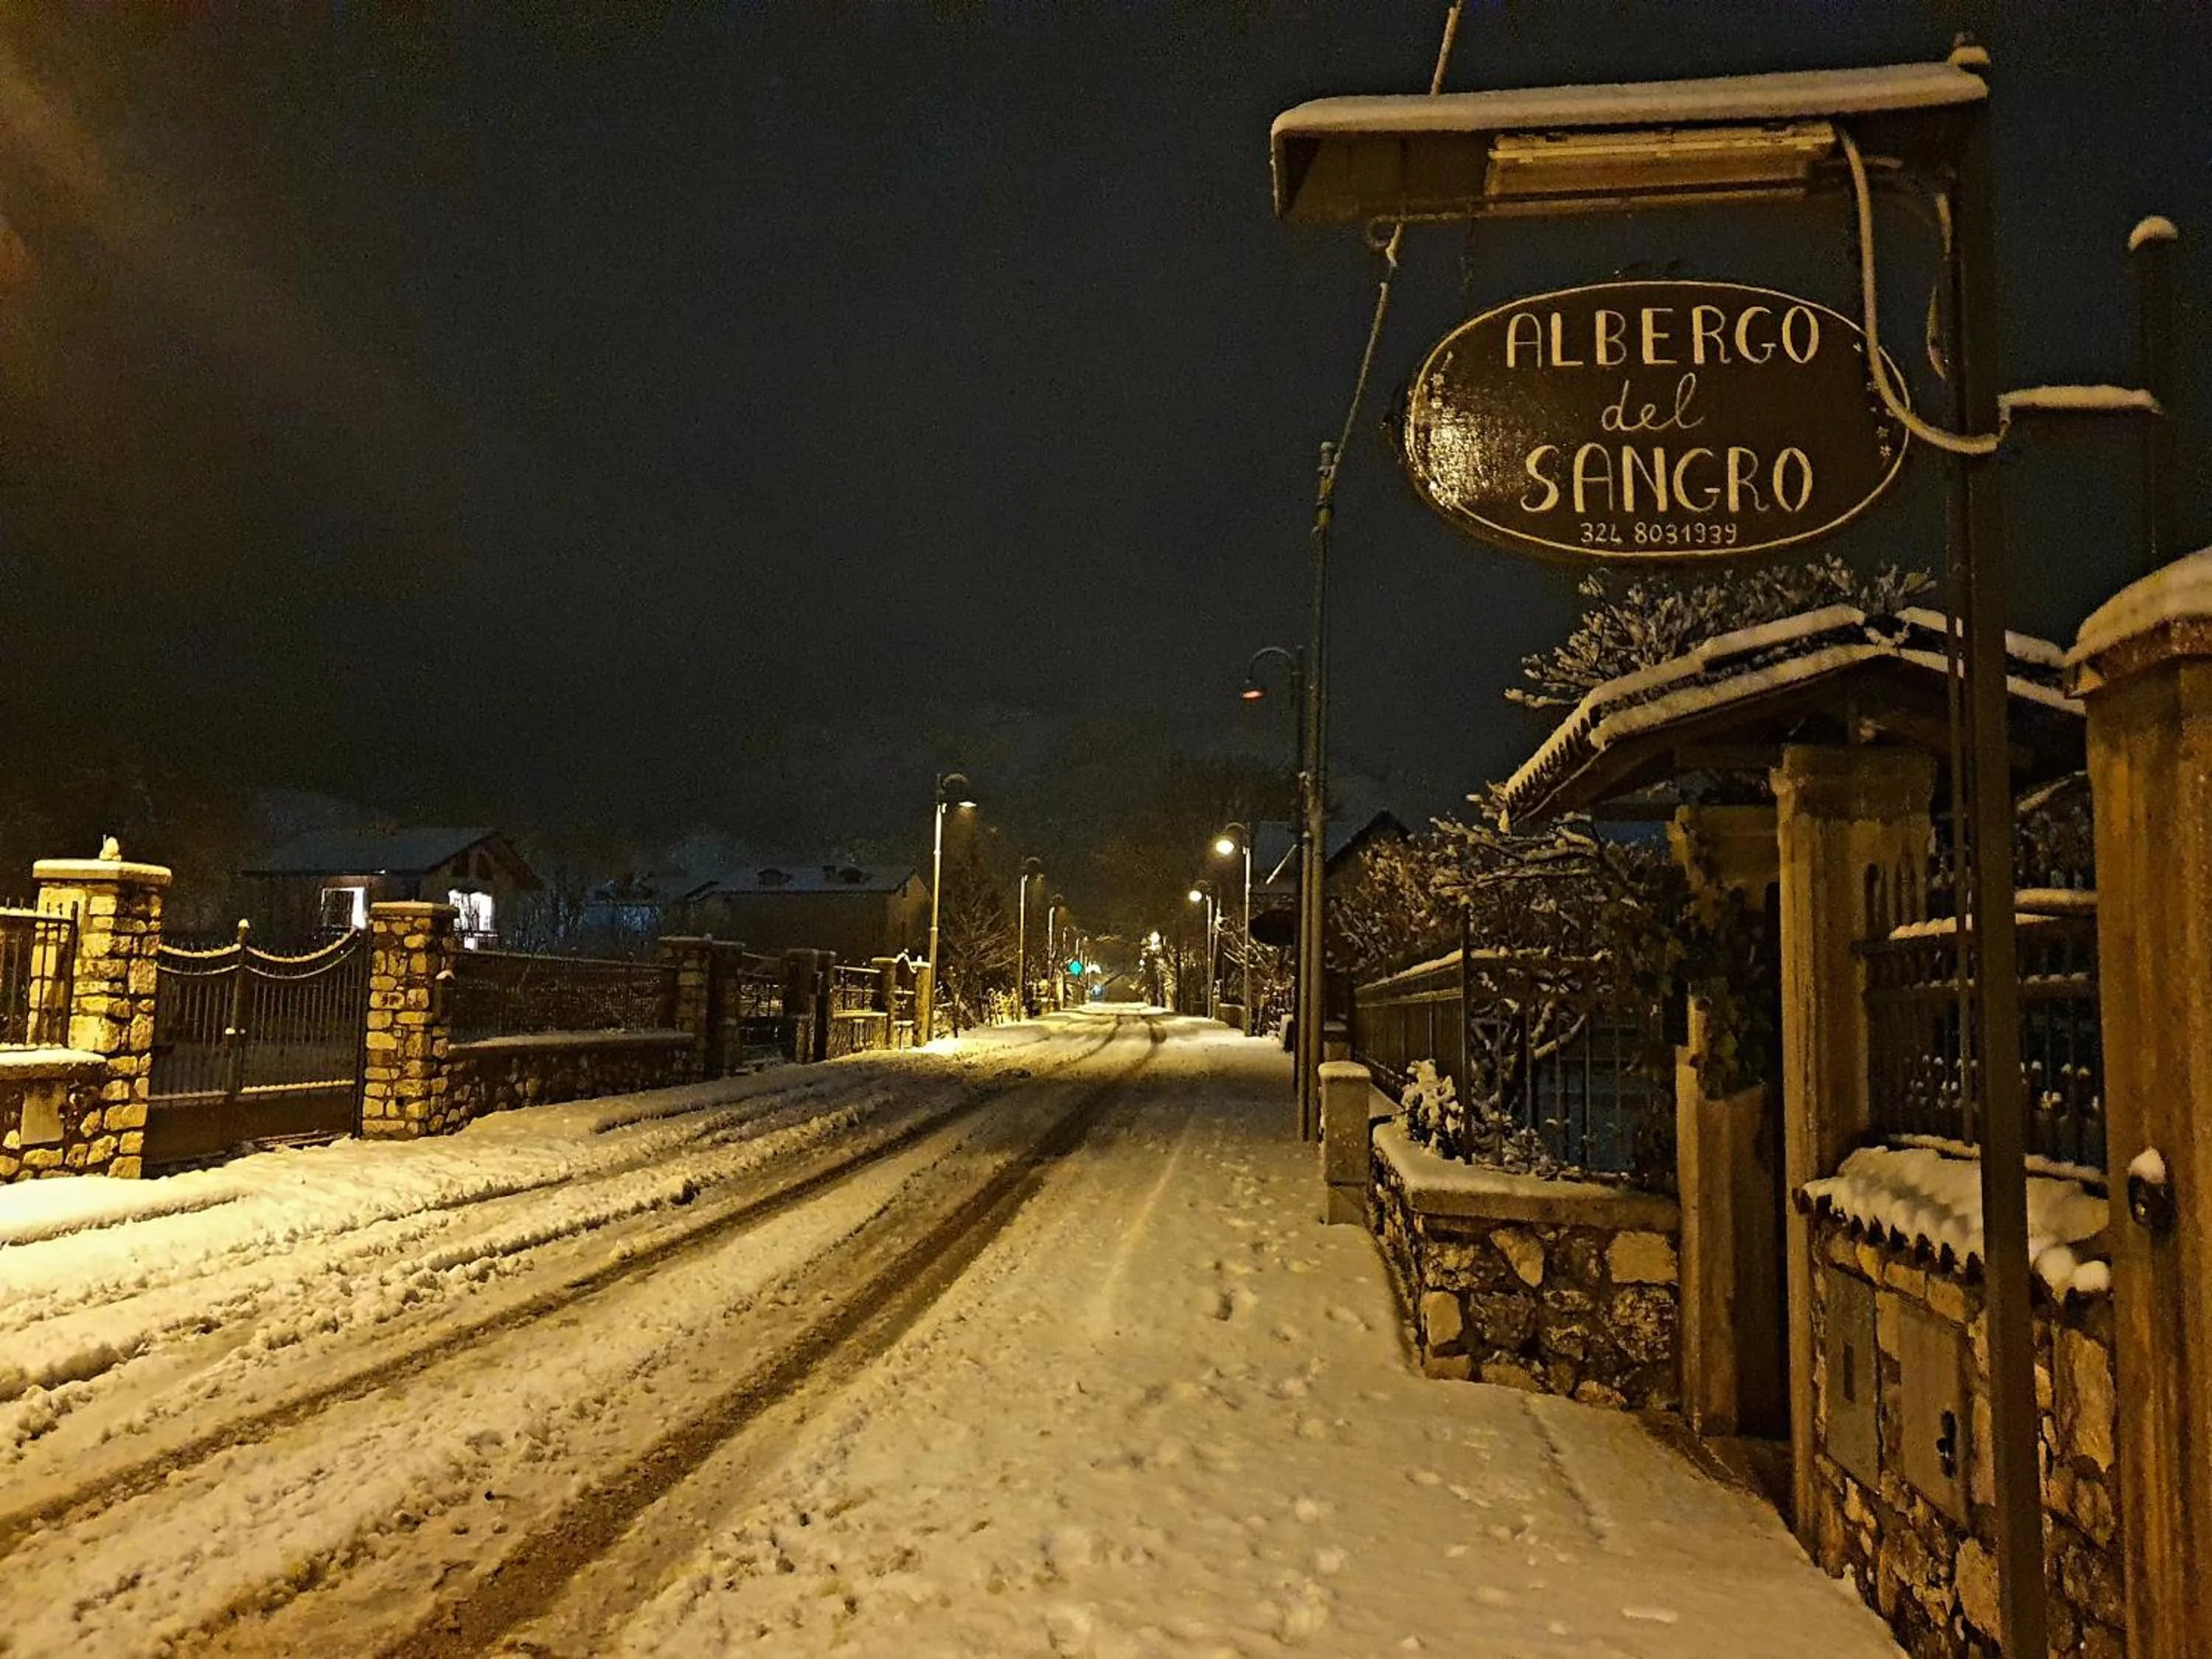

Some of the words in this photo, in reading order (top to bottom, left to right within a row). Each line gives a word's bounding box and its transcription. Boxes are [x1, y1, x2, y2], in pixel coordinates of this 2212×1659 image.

[1506, 305, 1820, 368] ALBERGO
[1601, 372, 1705, 432] del
[1520, 442, 1813, 513] SANGRO
[1580, 522, 1622, 544] 324
[1634, 521, 1737, 545] 8031939
